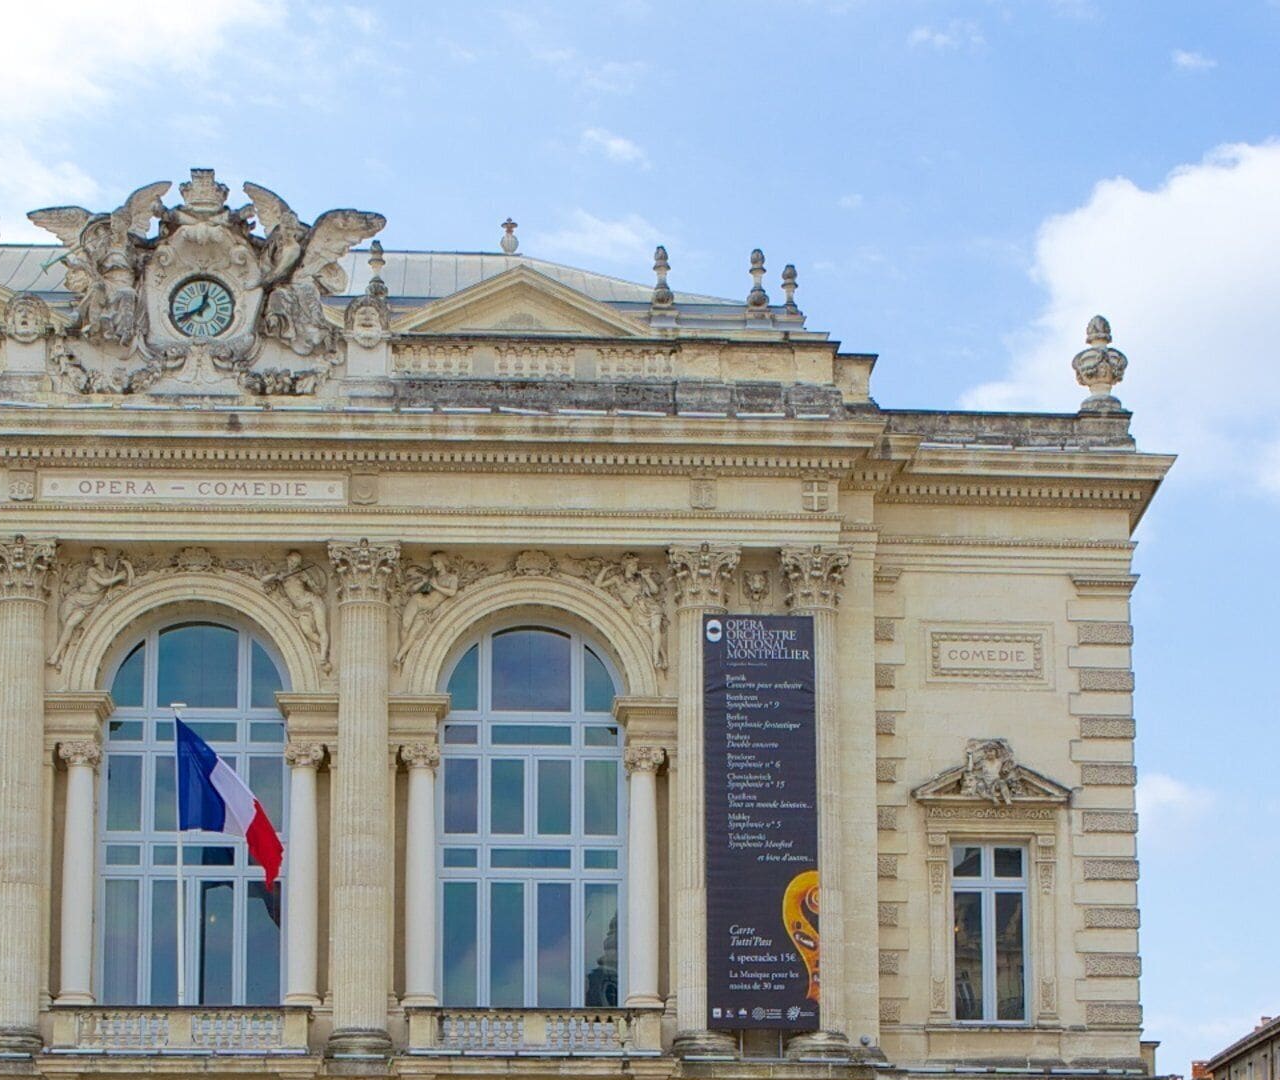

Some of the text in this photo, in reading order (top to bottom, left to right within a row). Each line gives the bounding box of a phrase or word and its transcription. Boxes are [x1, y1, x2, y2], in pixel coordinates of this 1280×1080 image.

[78, 480, 308, 497] OPERA COMEDIE
[726, 630, 796, 641] ORCHESTRE
[726, 640, 787, 650] NATIONAL
[726, 649, 811, 660] MONTPELLIER
[947, 649, 1025, 662] COMEDIE
[774, 701, 780, 709] 9
[776, 781, 785, 789] 15
[729, 924, 755, 935] Carte
[737, 953, 778, 964] spectacles
[729, 970, 799, 980] La Musique pour les
[752, 982, 761, 990] de
[762, 982, 771, 990] 30
